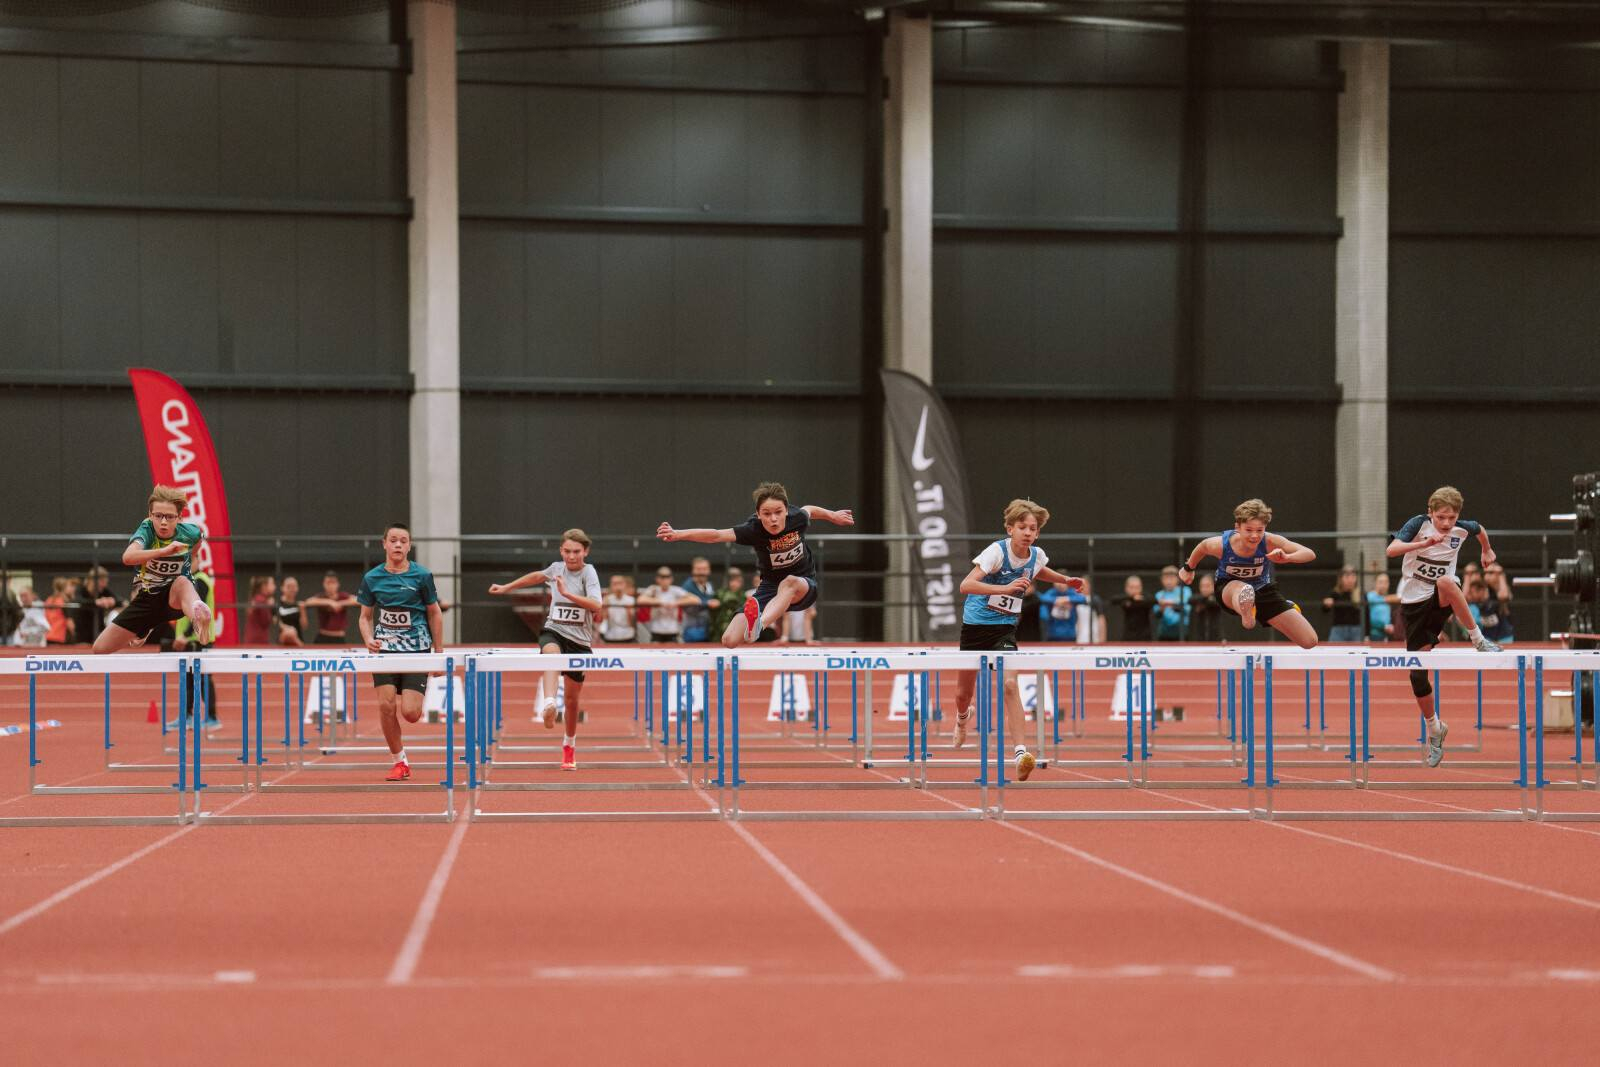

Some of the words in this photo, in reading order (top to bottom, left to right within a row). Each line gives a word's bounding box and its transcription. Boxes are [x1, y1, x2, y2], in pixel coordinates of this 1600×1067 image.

[774, 546, 800, 563] 443
[149, 560, 179, 573] 389
[1231, 568, 1257, 577] 251
[1417, 564, 1446, 578] 459
[998, 595, 1014, 610] 31
[382, 612, 408, 624] 430
[557, 608, 580, 620] 175
[25, 660, 84, 671] DIMA
[291, 659, 357, 671] DIMA
[568, 657, 625, 668] DIMA
[826, 657, 890, 669] DIMA
[1095, 656, 1151, 668] DIMA
[1365, 656, 1422, 667] DIMA
[1025, 684, 1038, 707] 2
[1131, 685, 1139, 707] 1
